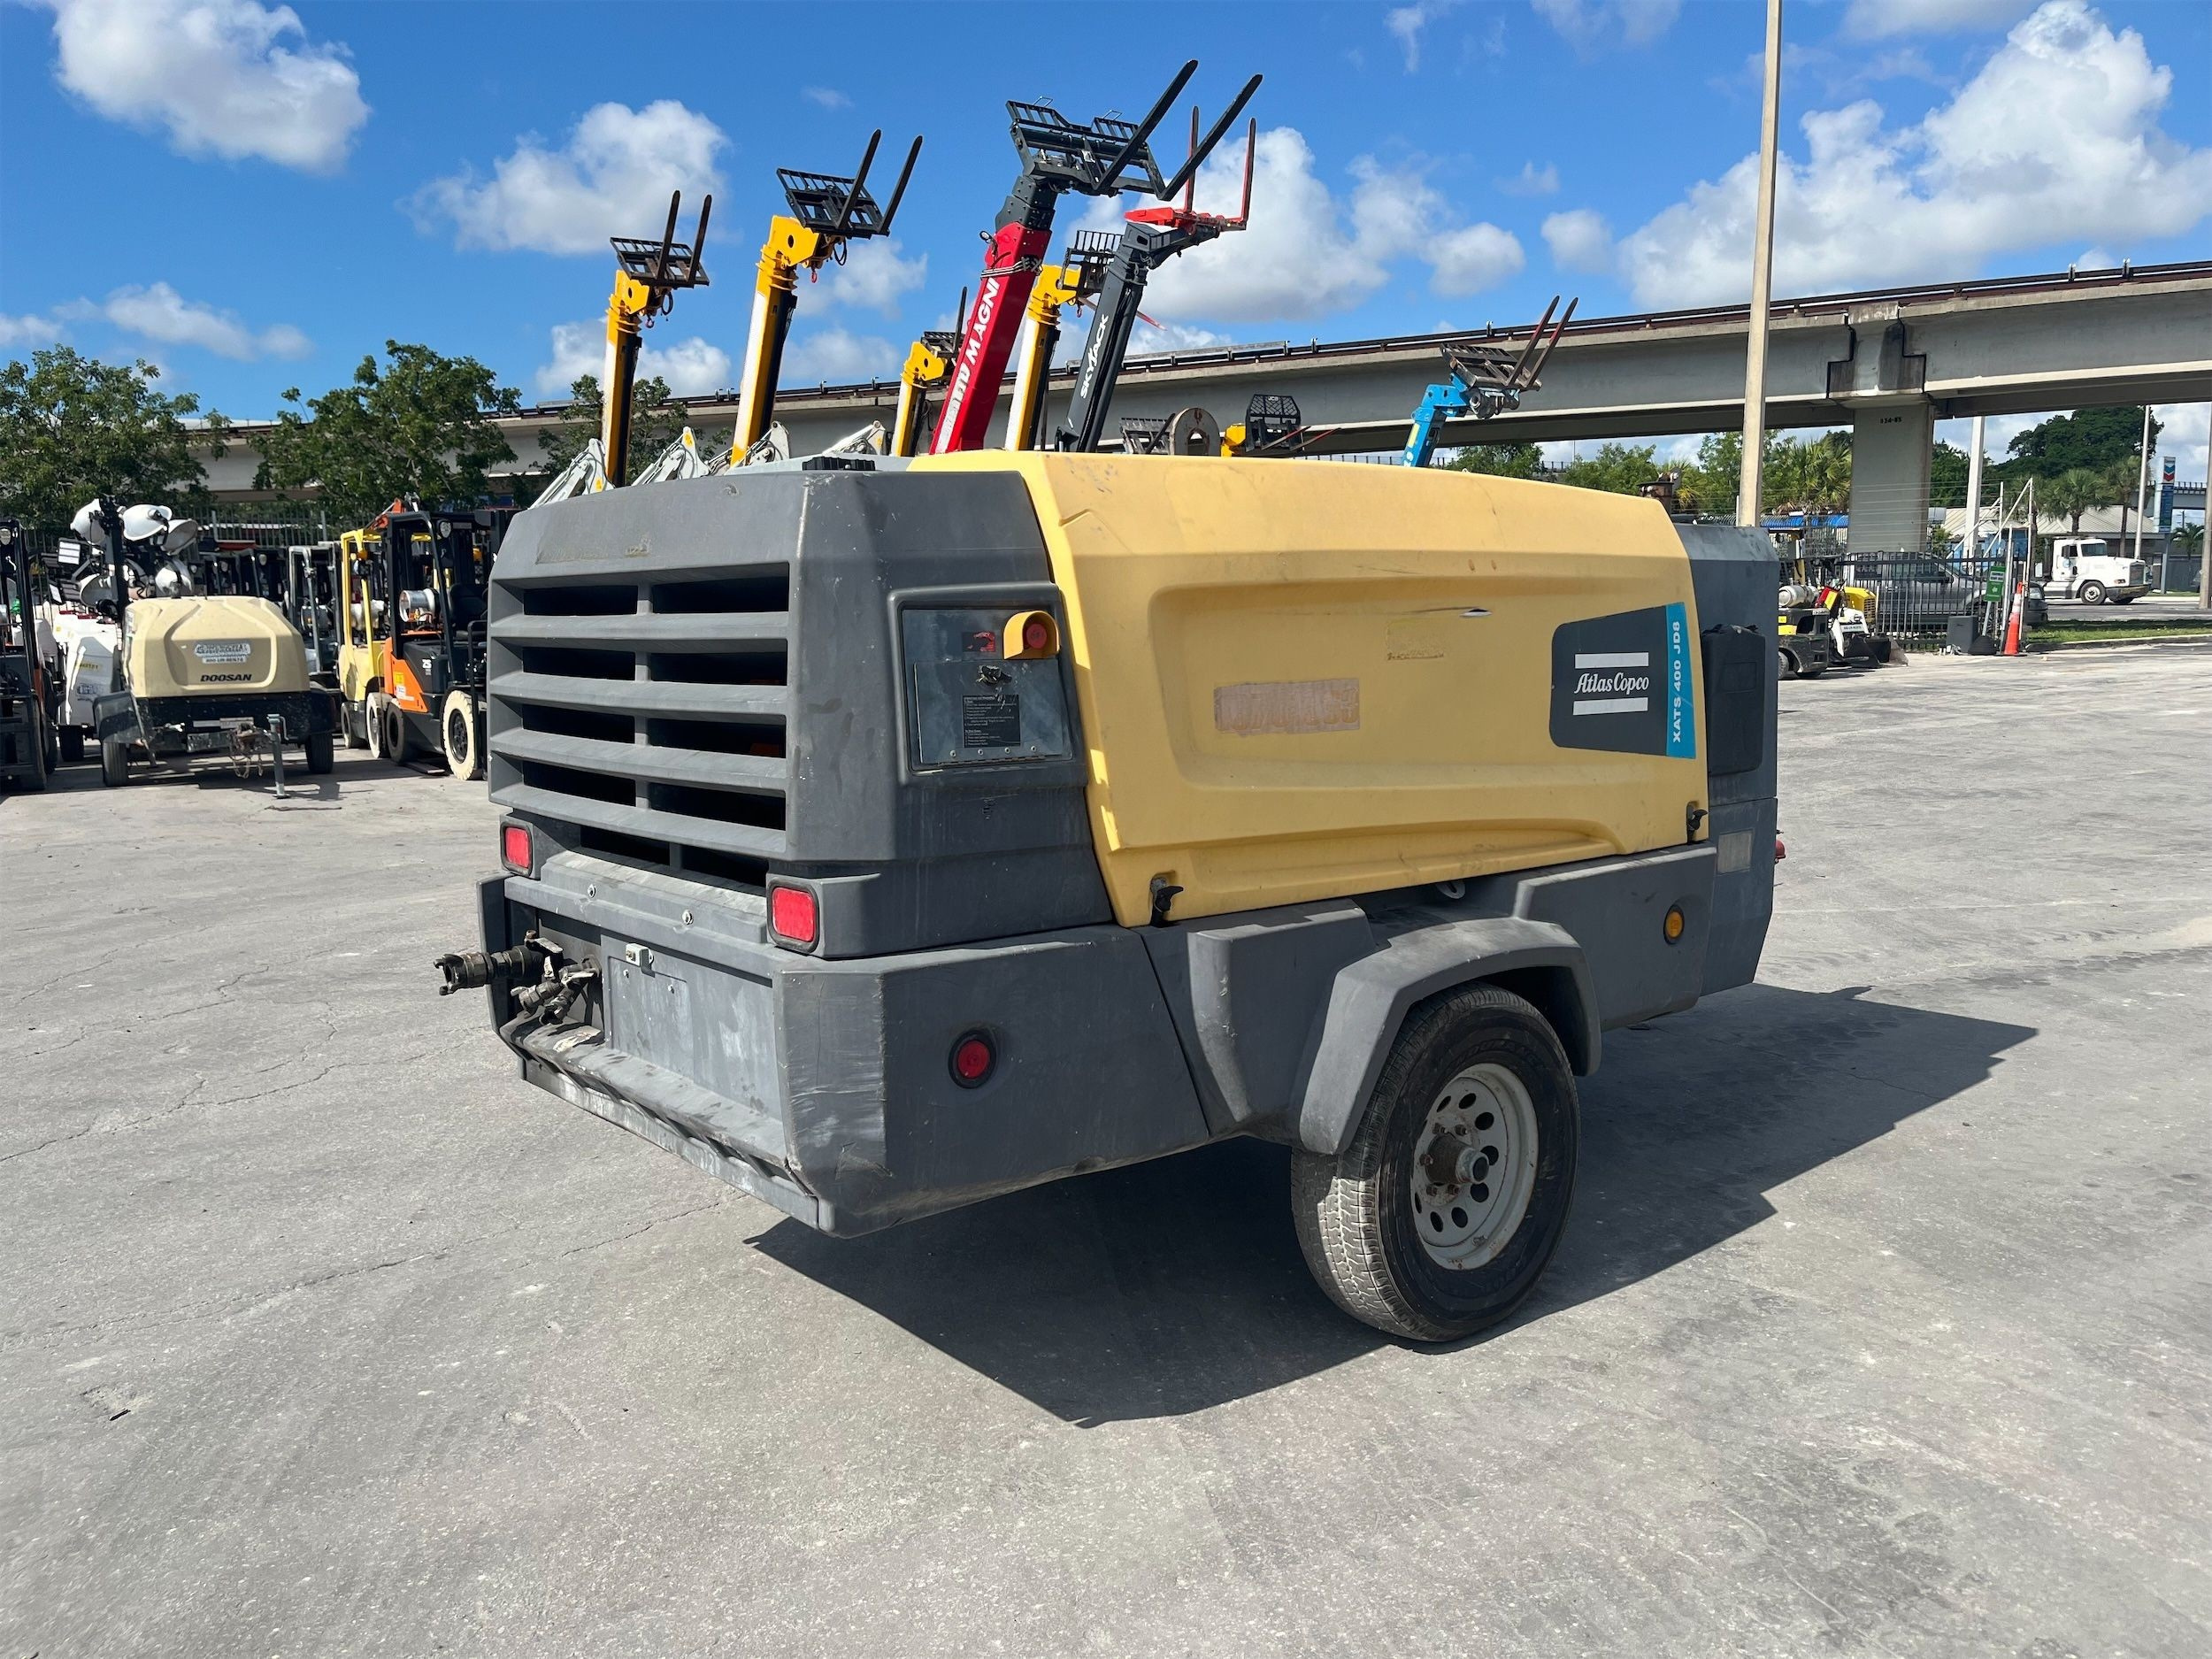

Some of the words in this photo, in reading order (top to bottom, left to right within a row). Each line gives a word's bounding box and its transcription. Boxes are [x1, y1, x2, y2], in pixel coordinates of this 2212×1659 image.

[965, 277, 1000, 365] MAGNI
[1080, 313, 1109, 399] SKYJACK
[200, 673, 252, 682] DOOSAN
[1574, 672, 1613, 694] Atlas
[1613, 672, 1649, 695] Copco
[1672, 696, 1681, 743] XATS
